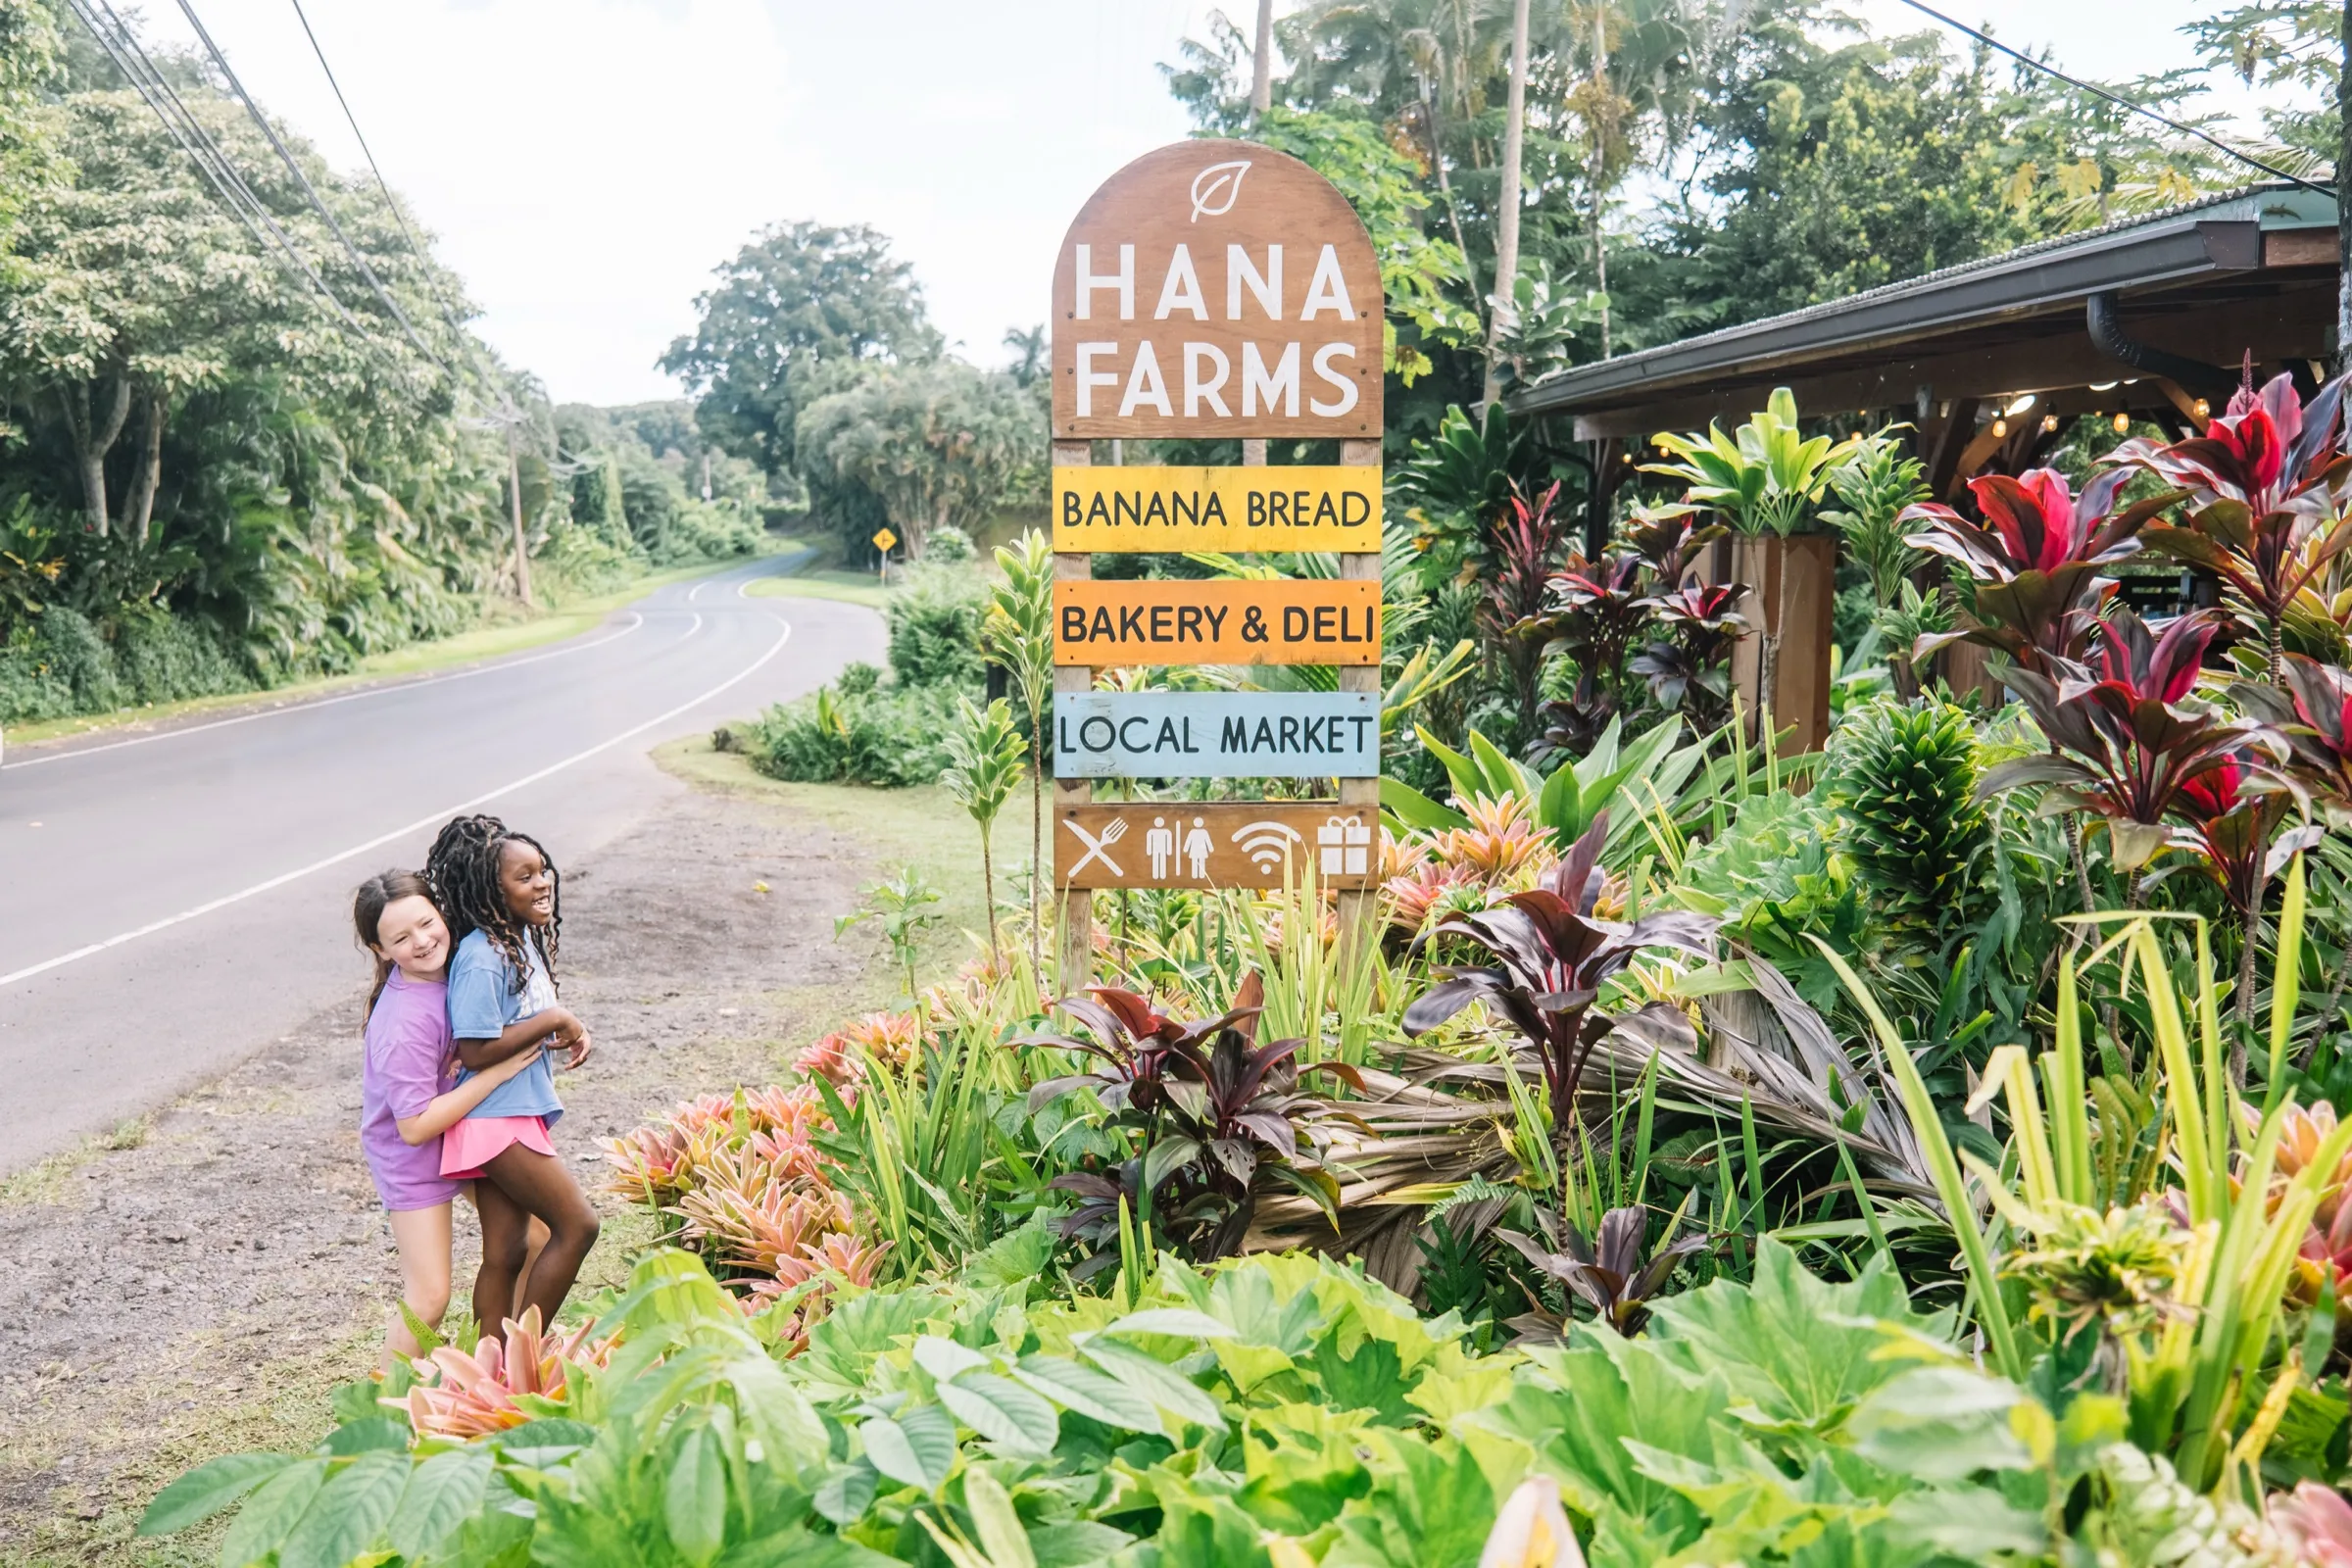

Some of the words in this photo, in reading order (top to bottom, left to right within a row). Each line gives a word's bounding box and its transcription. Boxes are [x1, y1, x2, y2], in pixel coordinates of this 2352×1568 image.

[1076, 244, 1355, 320] HANA
[1077, 341, 1358, 416] FARMS
[1064, 491, 1227, 526] BANANA
[1249, 492, 1370, 526] BREAD
[1062, 606, 1228, 642] BAKERY
[1242, 606, 1268, 642] &
[1284, 607, 1373, 642] DELI
[1060, 716, 1199, 753] LOCAL
[1221, 716, 1373, 753] MARKET
